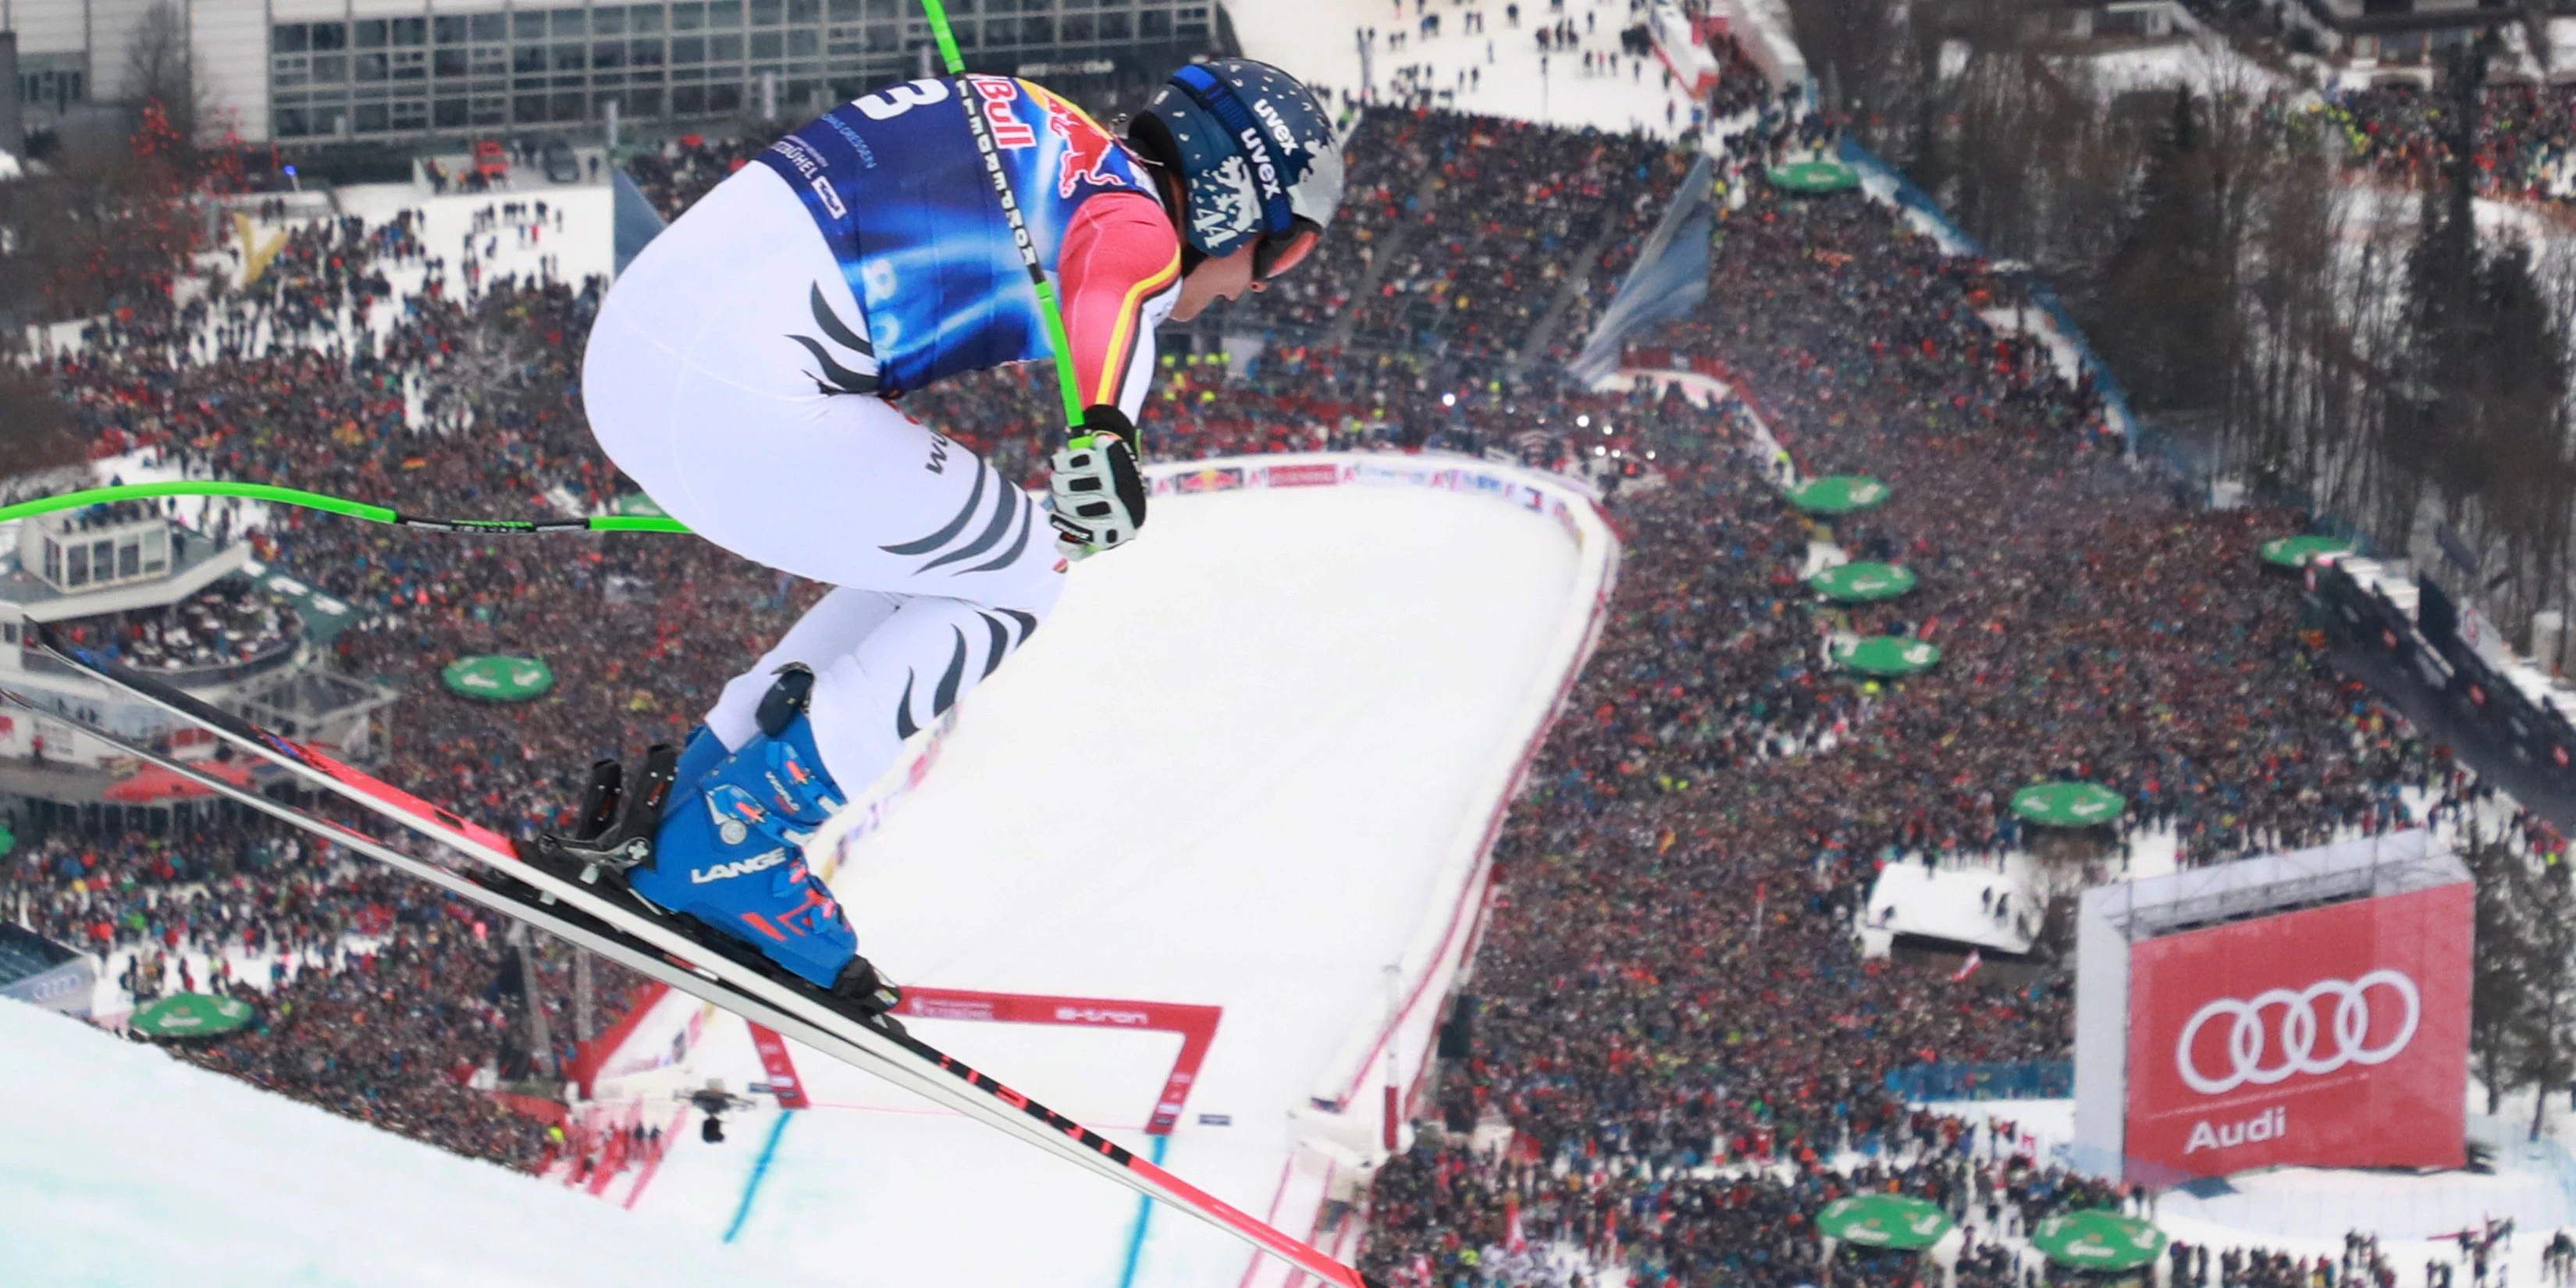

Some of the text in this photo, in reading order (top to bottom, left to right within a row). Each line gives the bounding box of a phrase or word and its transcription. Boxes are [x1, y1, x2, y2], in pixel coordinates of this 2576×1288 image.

[851, 78, 950, 120] 3
[973, 80, 1037, 148] Bull
[1253, 98, 1299, 155] uvex
[955, 79, 1038, 266] KOMPERDELL
[1240, 126, 1282, 200] uvex
[690, 846, 788, 884] LANGE
[2183, 1105, 2286, 1155] Audi
